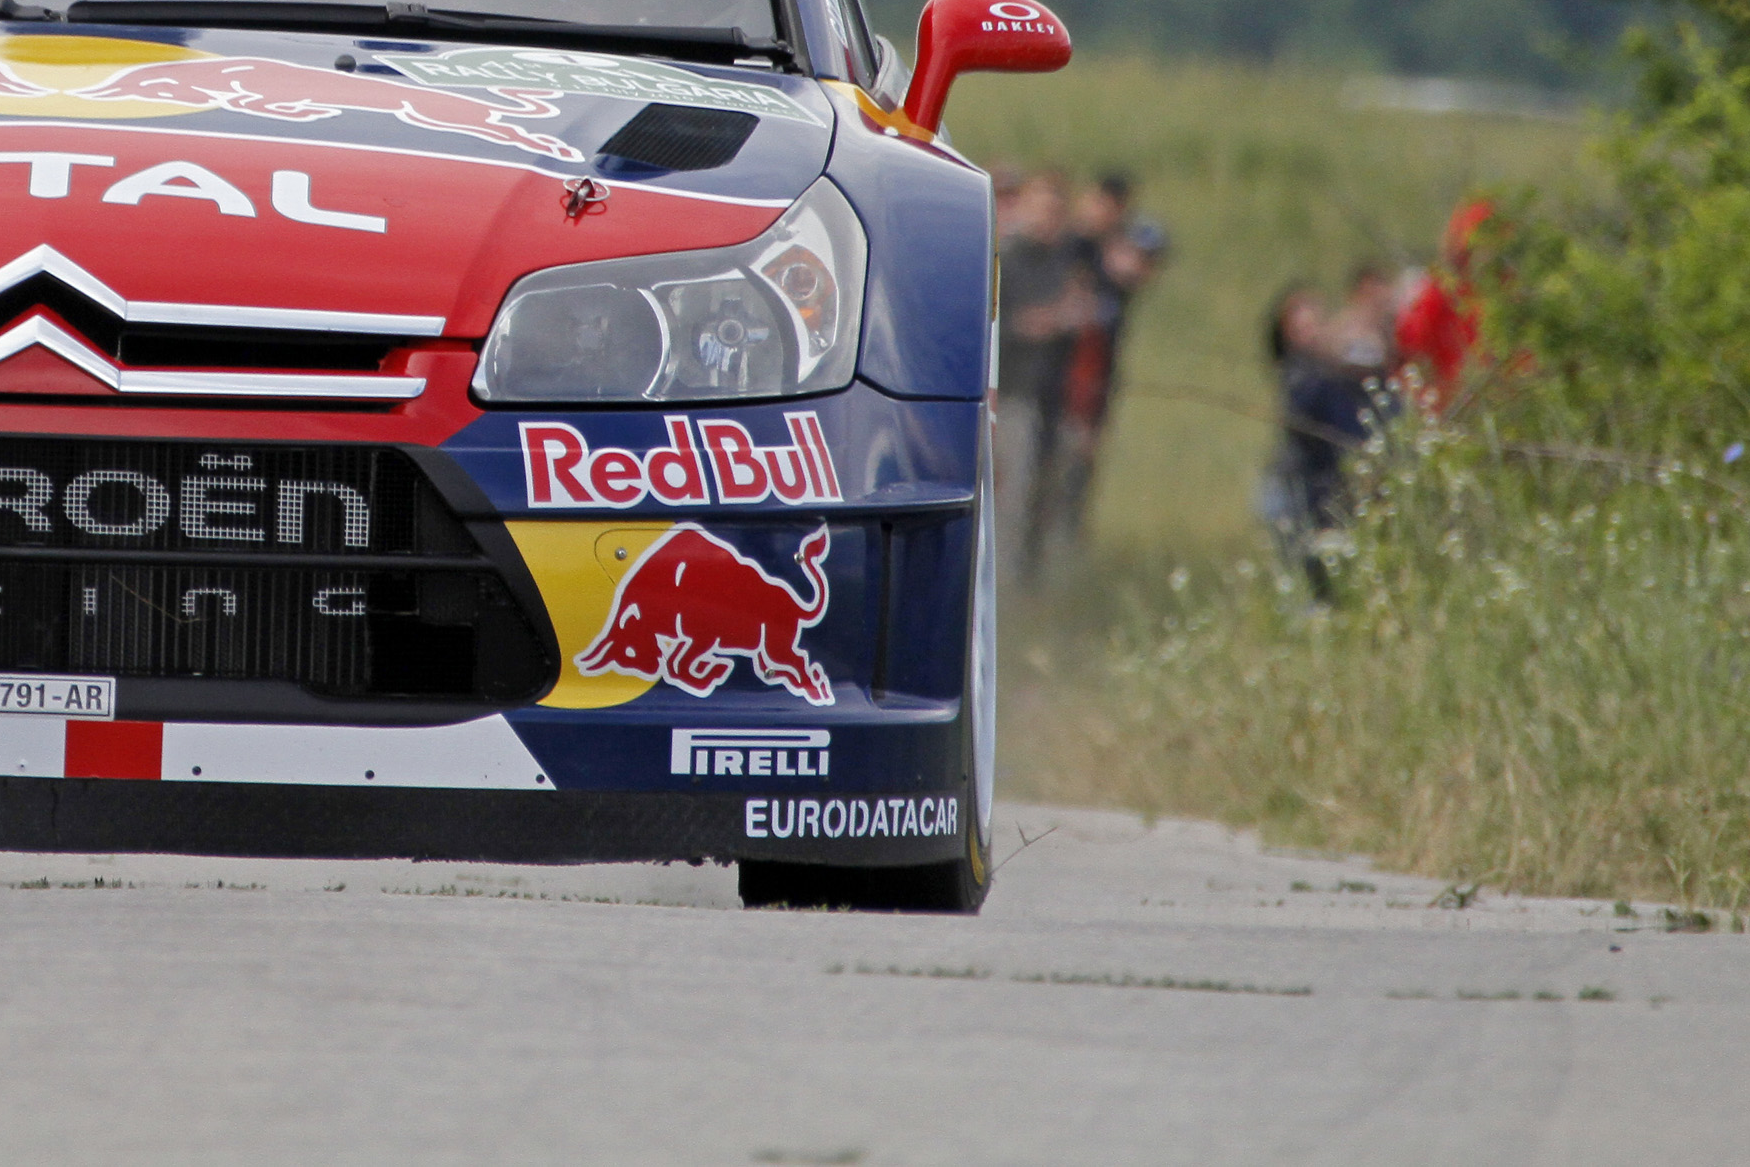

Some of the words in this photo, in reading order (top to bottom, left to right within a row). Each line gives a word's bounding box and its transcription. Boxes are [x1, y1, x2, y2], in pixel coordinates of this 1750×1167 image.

[981, 21, 1054, 35] OAKLEY
[410, 61, 558, 83] RALLY
[569, 74, 790, 109] BULGARIA
[518, 414, 710, 508] Red
[696, 411, 844, 505] Bull
[670, 729, 830, 775] PIRELLI
[746, 797, 959, 838] EURODATACAR
